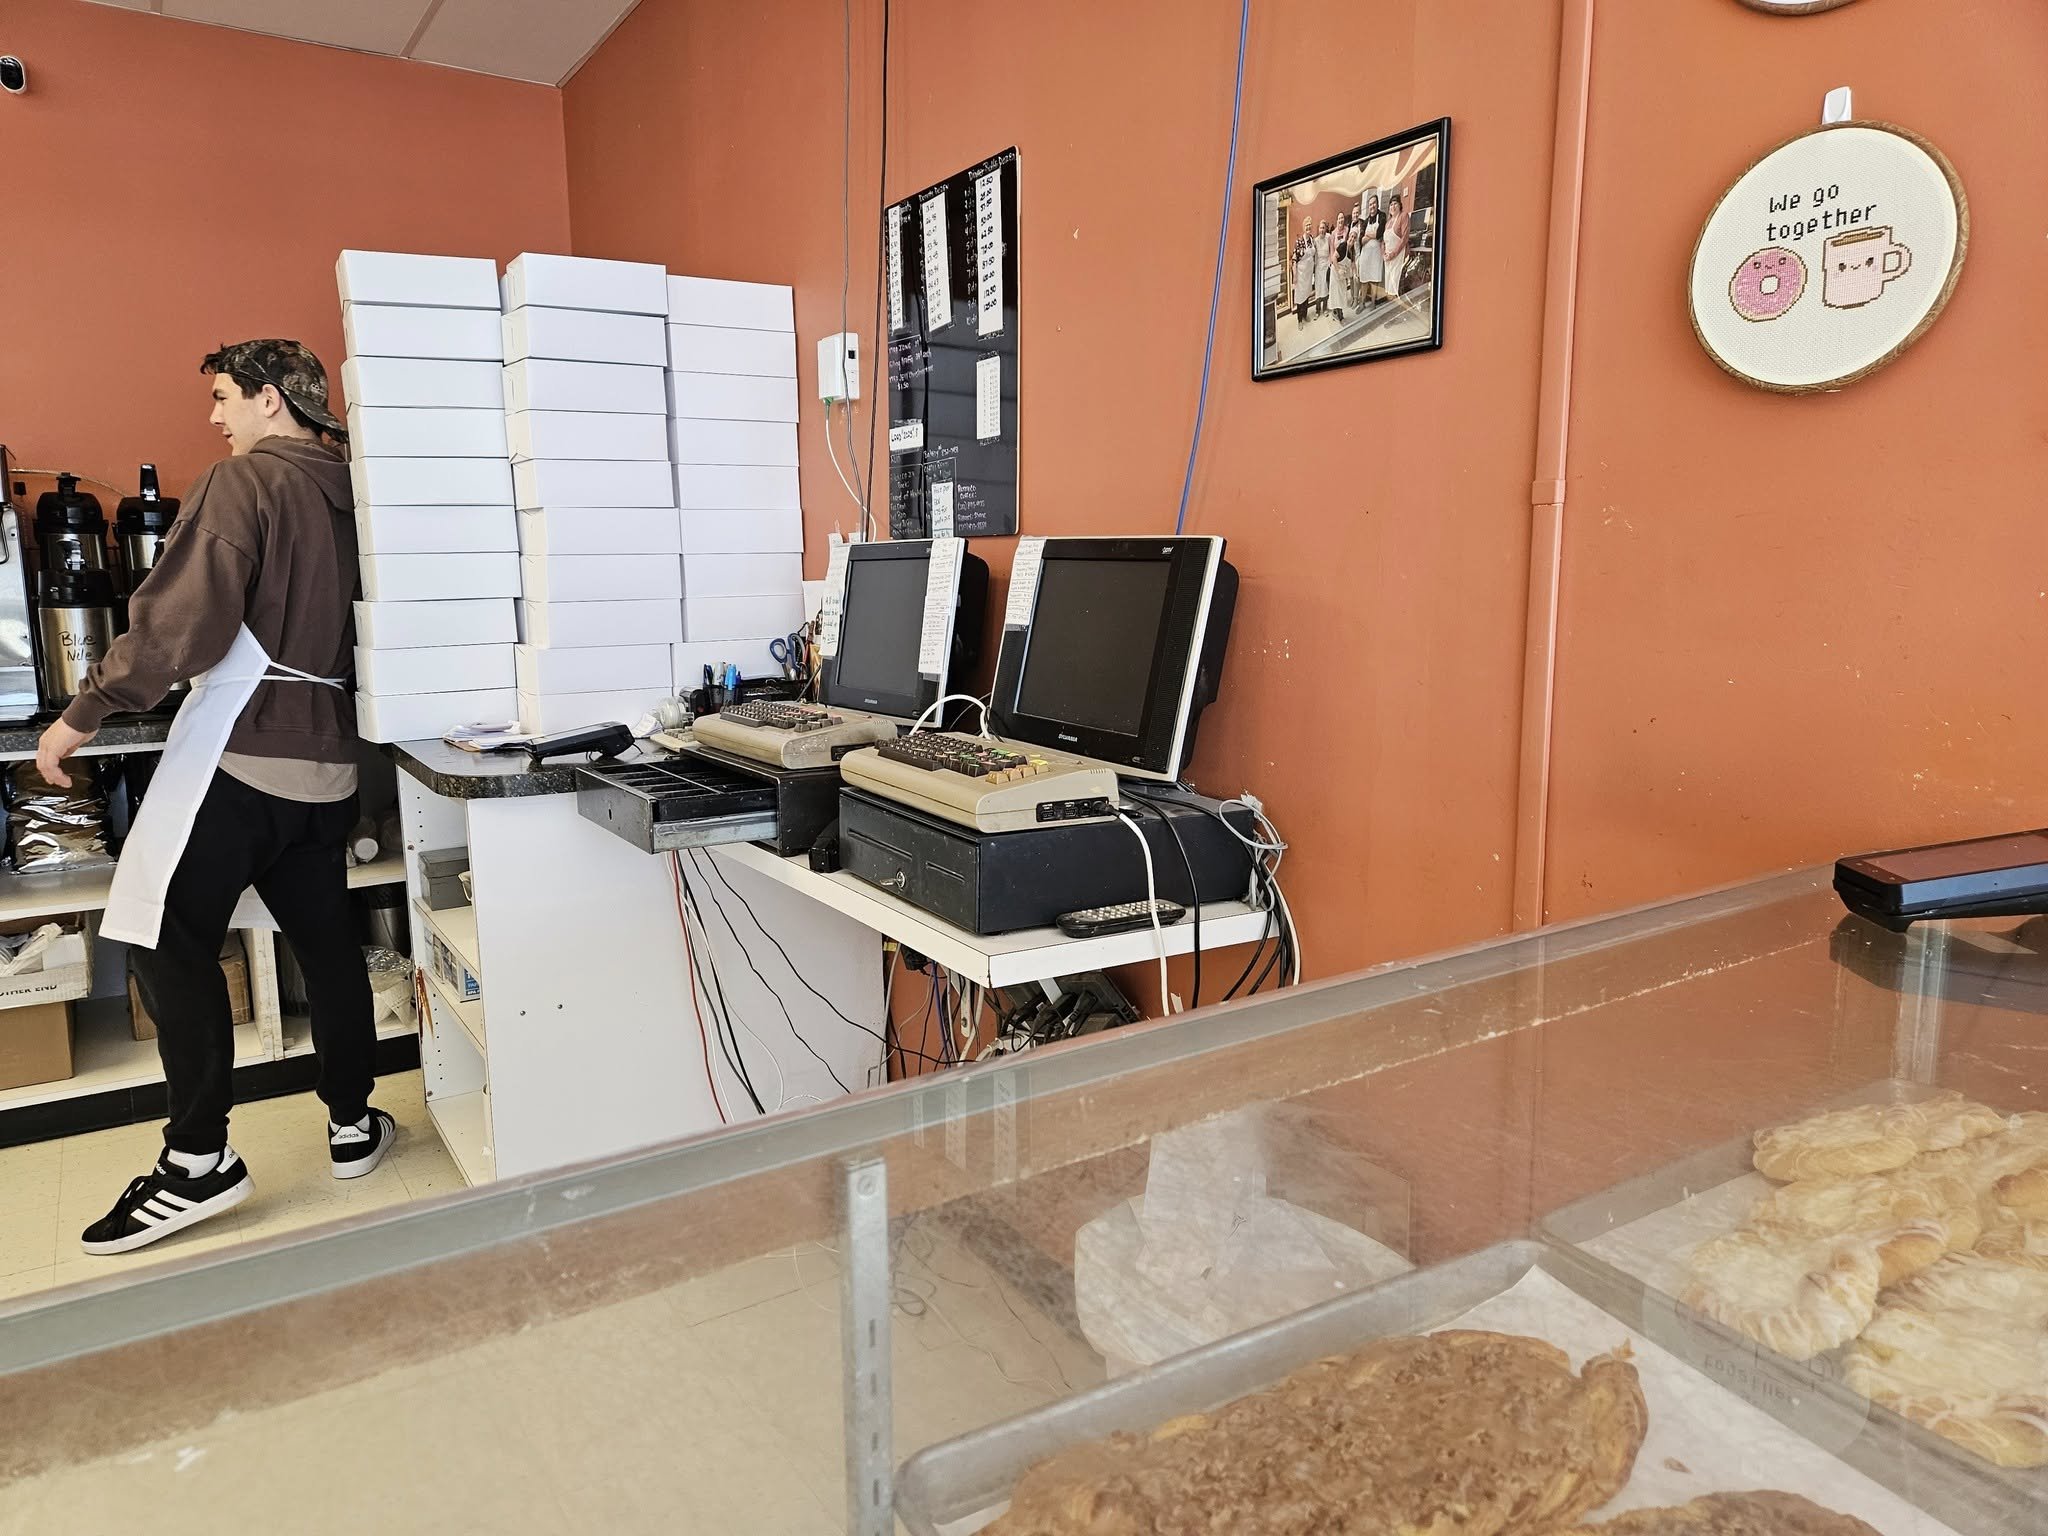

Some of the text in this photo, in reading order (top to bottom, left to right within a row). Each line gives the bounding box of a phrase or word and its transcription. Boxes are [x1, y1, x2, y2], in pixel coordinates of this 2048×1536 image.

[1769, 184, 1839, 213] We go
[1766, 204, 1877, 241] together
[57, 631, 97, 647] Blue
[67, 648, 97, 662] Nile
